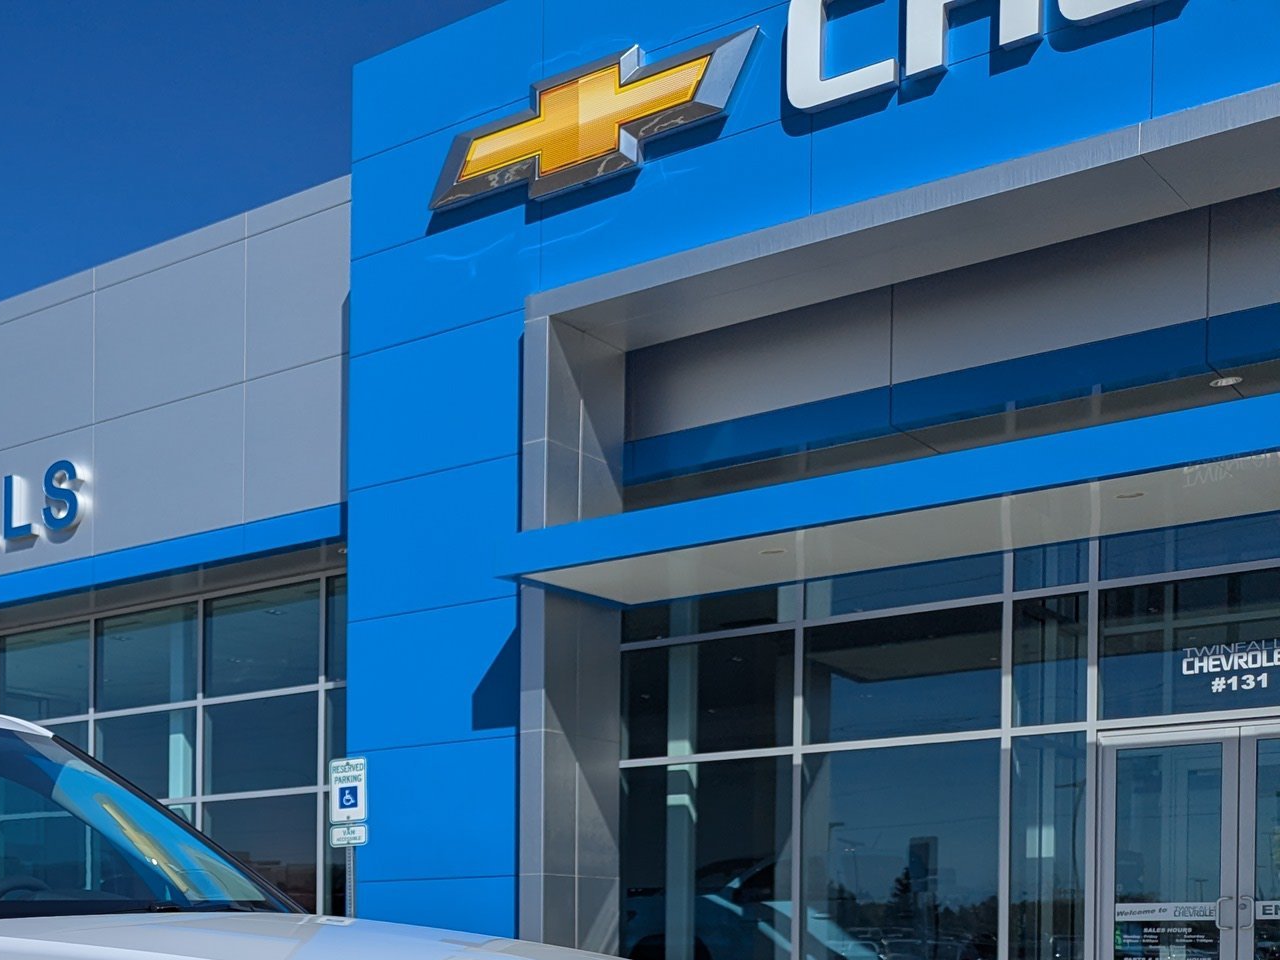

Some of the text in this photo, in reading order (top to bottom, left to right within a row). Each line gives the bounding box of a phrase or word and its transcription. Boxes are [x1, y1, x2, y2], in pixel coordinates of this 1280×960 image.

[1211, 672, 1268, 693] #131
[332, 763, 364, 774] RESERVED
[334, 774, 362, 785] PARKING
[1117, 909, 1156, 917] Welcome
